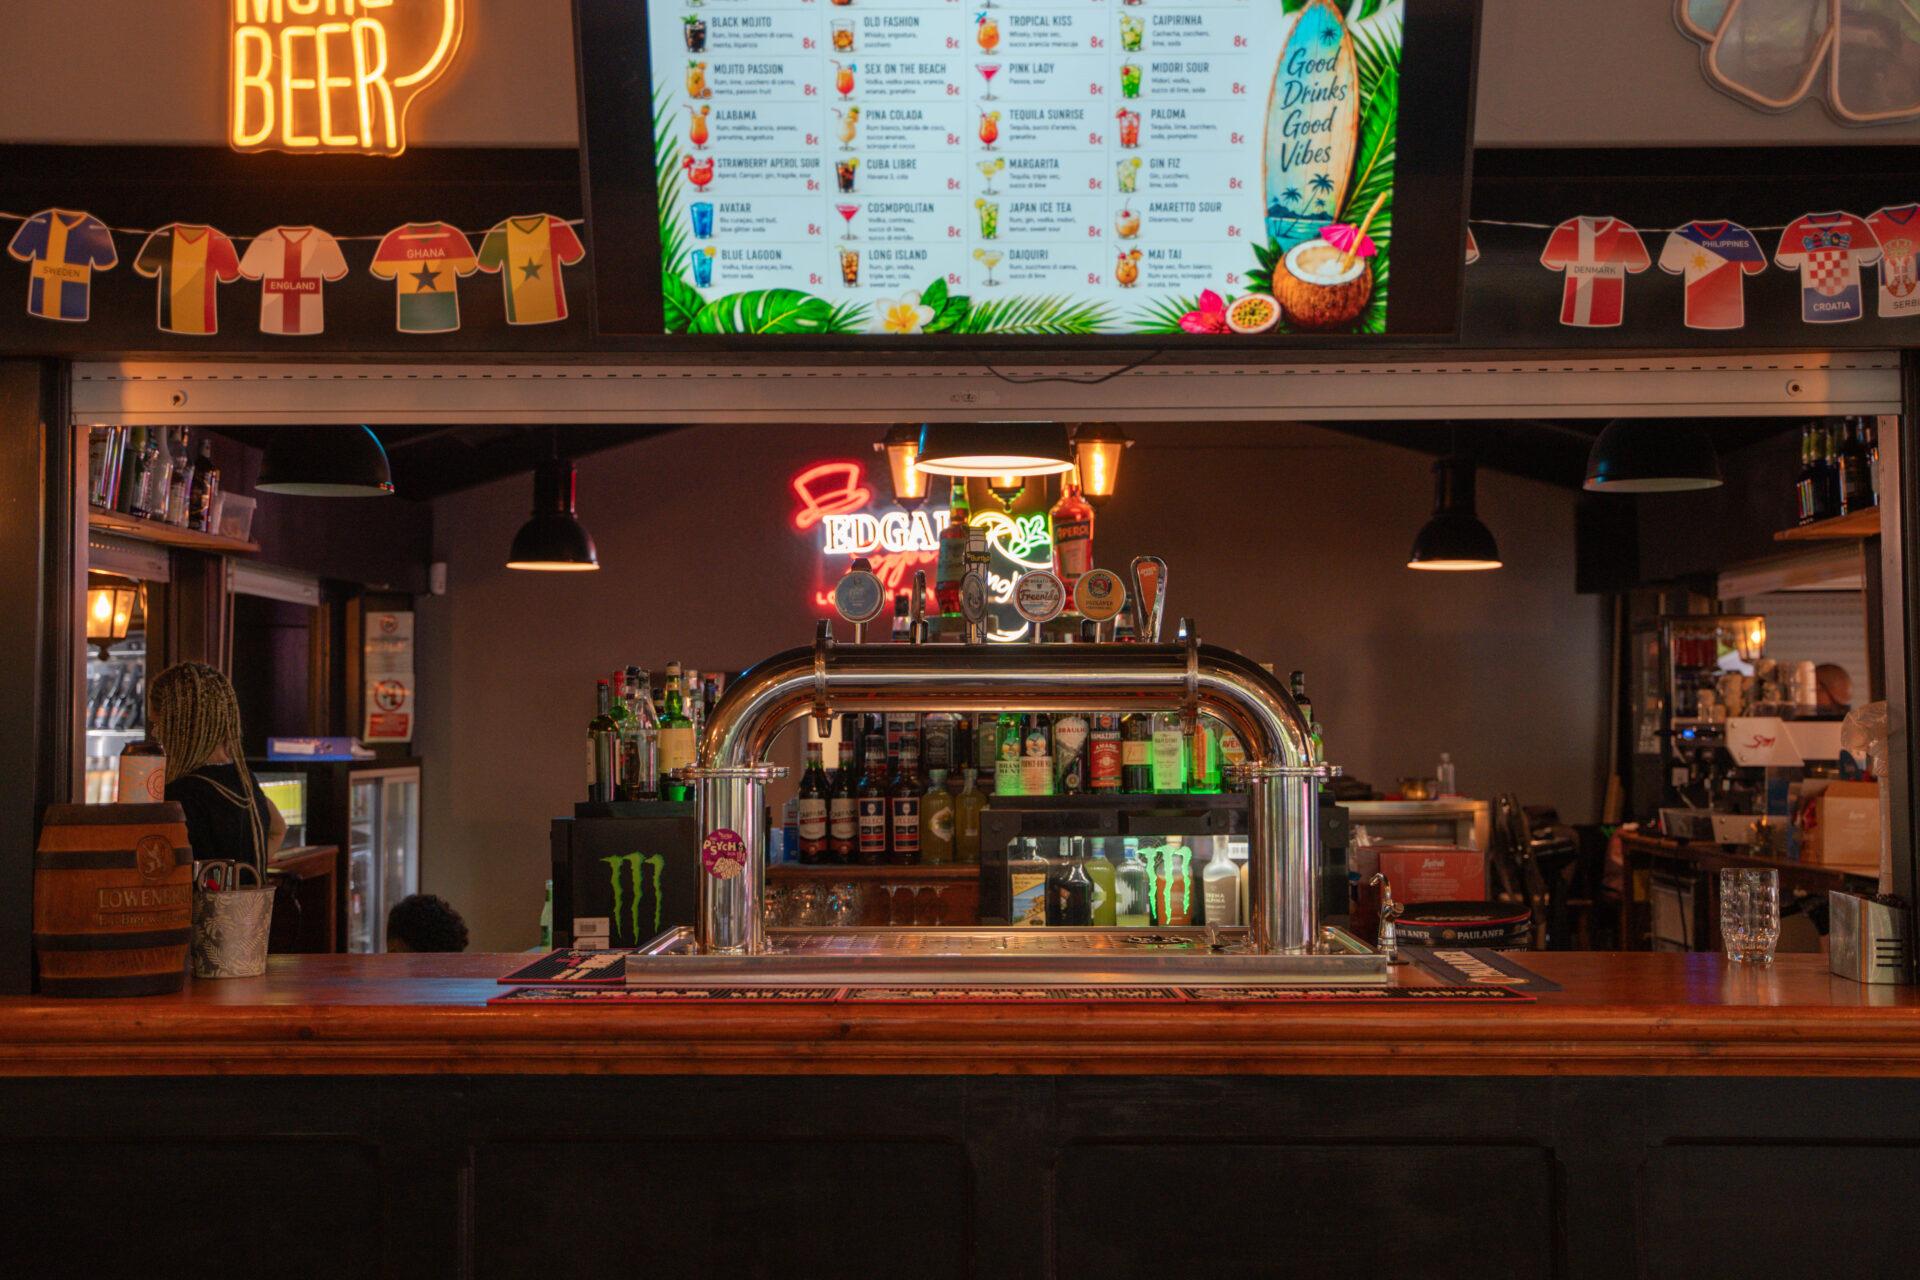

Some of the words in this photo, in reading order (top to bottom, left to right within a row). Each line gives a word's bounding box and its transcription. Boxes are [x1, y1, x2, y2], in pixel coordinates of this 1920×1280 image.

[712, 16, 739, 28] BLACK
[741, 16, 772, 28] MOJITO
[864, 16, 881, 27] OLD
[883, 16, 919, 27] FASHION
[1009, 15, 1050, 26] TROPICAL
[1052, 15, 1072, 26] KISS
[1152, 15, 1203, 26] CAIPIRINHA
[1152, 62, 1184, 73] MIDORI
[1185, 62, 1210, 73] SOUR
[1286, 46, 1342, 78] Good
[714, 64, 746, 74] MOJITO
[747, 64, 784, 74] PASSION
[865, 64, 882, 74] SEX
[883, 64, 898, 74] ON
[899, 64, 916, 74] THE
[918, 64, 947, 74] BEACH
[1009, 63, 1030, 73] PINK
[1032, 63, 1055, 73] LADY
[233, 18, 397, 147] BEER
[1280, 75, 1348, 110] Drinks
[716, 110, 757, 120] ALABAMA
[866, 110, 887, 120] PINA
[888, 110, 923, 120] COLADA
[1009, 109, 1046, 120] TEQUILA
[1047, 109, 1084, 120] SUNRISE
[1151, 109, 1186, 119] PALOMA
[1282, 106, 1338, 139] Good
[1280, 138, 1332, 173] Vibes
[718, 158, 768, 169] STRAWBERRY
[770, 158, 799, 169] APEROL
[800, 158, 821, 169] SOUR
[867, 159, 890, 169] CUBA
[892, 159, 917, 169] LIBRE
[1009, 158, 1060, 168] MARGARITA
[1150, 159, 1165, 168] GIN
[1167, 159, 1181, 168] FIZ
[720, 203, 752, 213] AVATAR
[868, 203, 935, 213] COSMOPOLITAN
[1009, 202, 1037, 213] JAPAN
[1039, 202, 1054, 213] ICE
[1055, 202, 1072, 213] TEA
[1149, 202, 1197, 212] AMARETTO
[1198, 202, 1222, 212] SOUR
[1701, 240, 1750, 249] PHILIPPINES
[406, 247, 446, 259] GHANA
[721, 250, 744, 260] BLUE
[745, 250, 782, 260] LAGOON
[869, 250, 893, 260] LONG
[894, 250, 928, 260] ISLAND
[1009, 249, 1049, 260] DAIQUIRI
[1148, 249, 1166, 259] MAI
[1167, 249, 1182, 259] TAI
[42, 265, 81, 278] SWEDEN
[1573, 265, 1617, 275] DENMARK
[270, 280, 316, 291] ENGLAND
[1812, 301, 1851, 312] CROATIA
